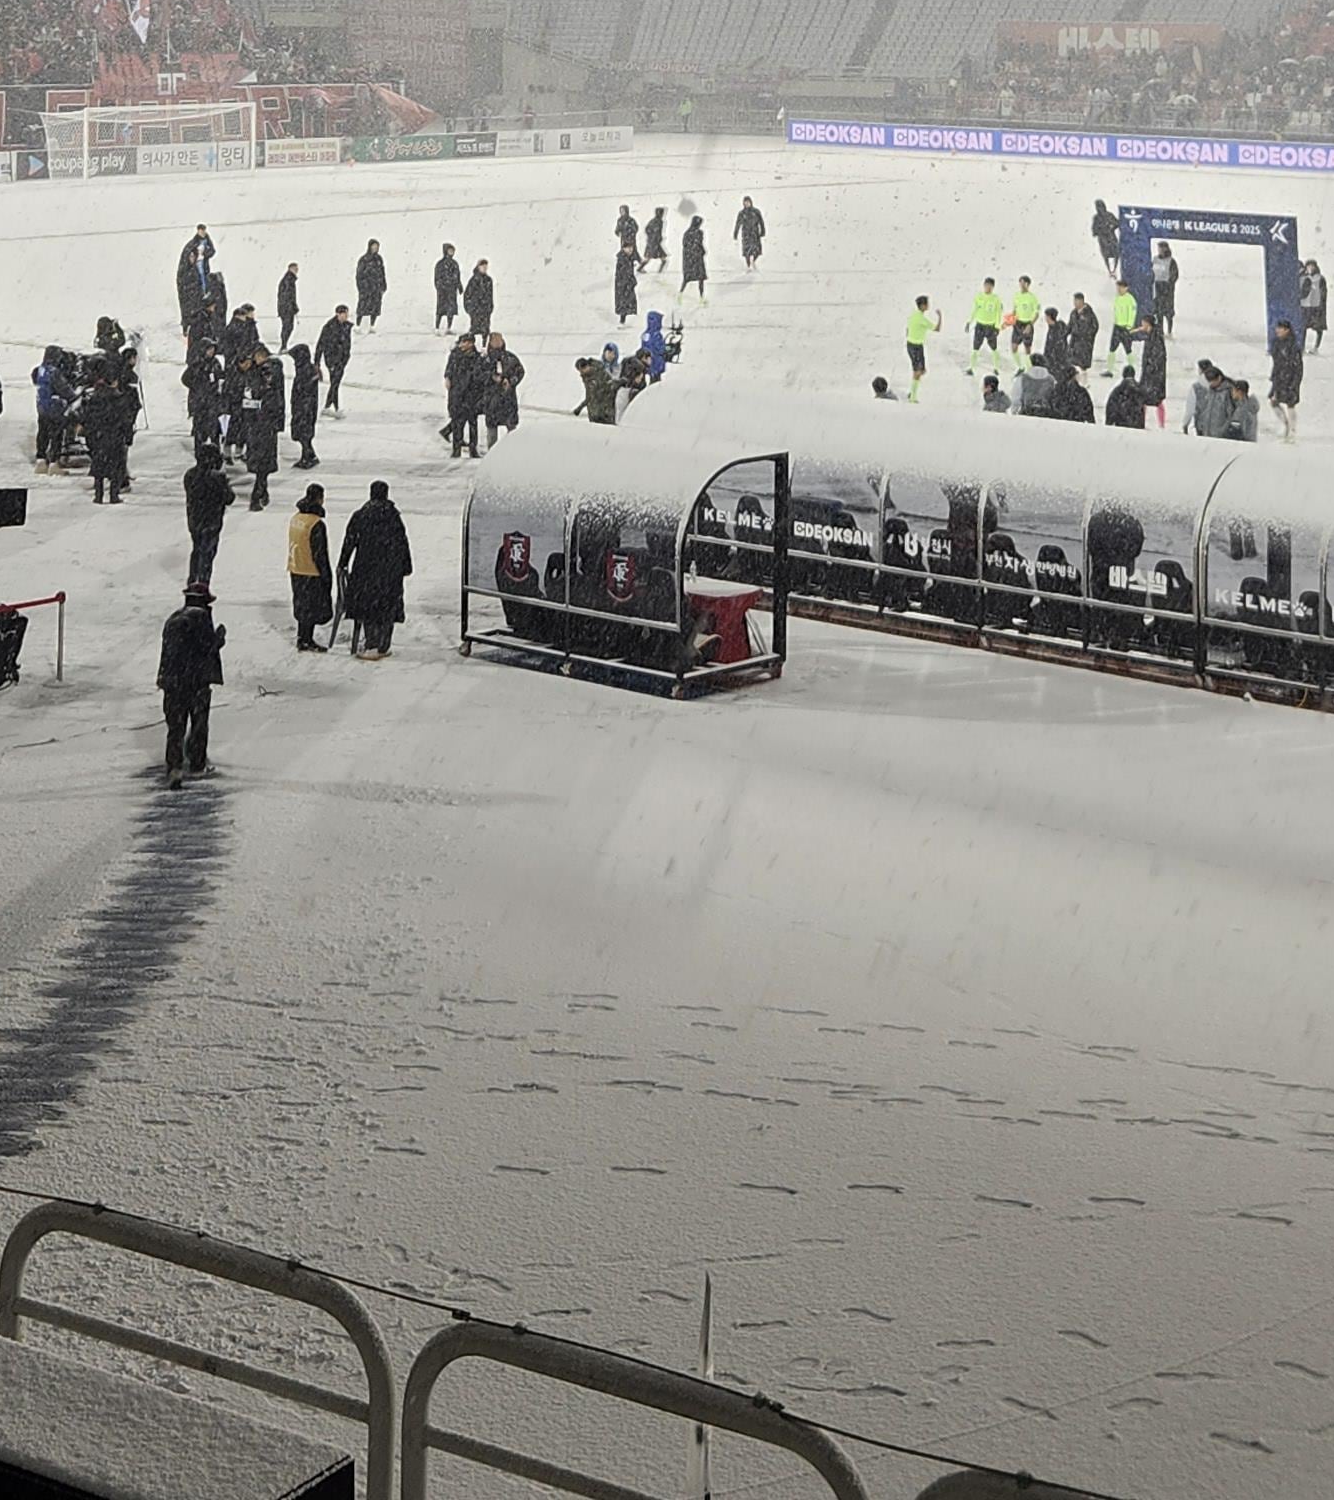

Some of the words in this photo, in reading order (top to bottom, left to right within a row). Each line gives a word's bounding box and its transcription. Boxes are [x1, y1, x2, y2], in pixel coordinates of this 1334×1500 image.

[805, 124, 885, 146] DEOKSAN
[907, 129, 993, 150] DEOKSAN
[1017, 135, 1107, 156] DEOKSAN
[142, 151, 175, 167] 의사가
[178, 150, 199, 165] 만든
[221, 147, 245, 167] 링티
[1132, 139, 1228, 163] DEOKSAN
[102, 153, 126, 171] play
[1184, 220, 1192, 230] K
[1194, 221, 1230, 233] LEAGUE
[1232, 223, 1238, 234] 2
[1240, 224, 1261, 235] 2025
[704, 507, 762, 529] KELME
[805, 523, 873, 547] DEOKSAN
[1214, 588, 1291, 615] KELME
